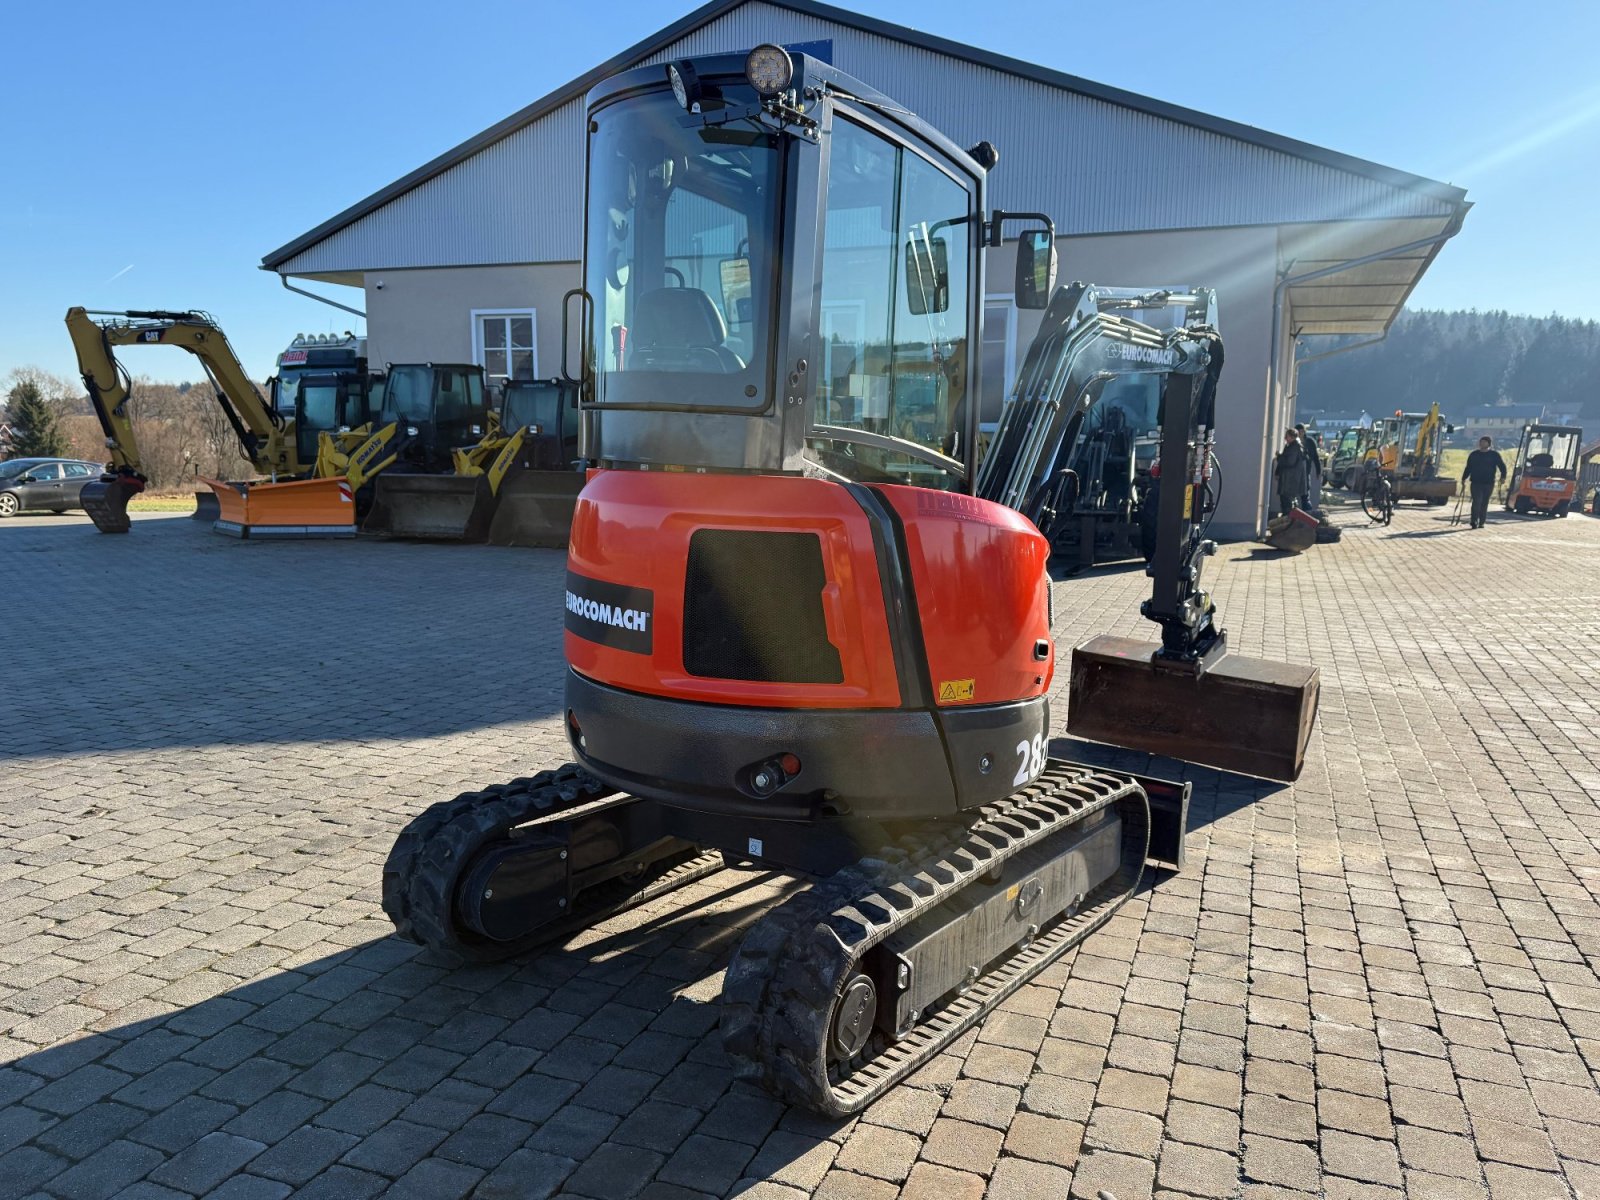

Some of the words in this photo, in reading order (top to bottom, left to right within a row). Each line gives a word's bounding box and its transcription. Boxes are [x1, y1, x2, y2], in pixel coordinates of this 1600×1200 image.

[145, 331, 159, 342] CAT
[1122, 344, 1173, 365] EUROCOMACH
[356, 437, 382, 464] KOMATSU
[566, 591, 646, 632] EUROCOMACH
